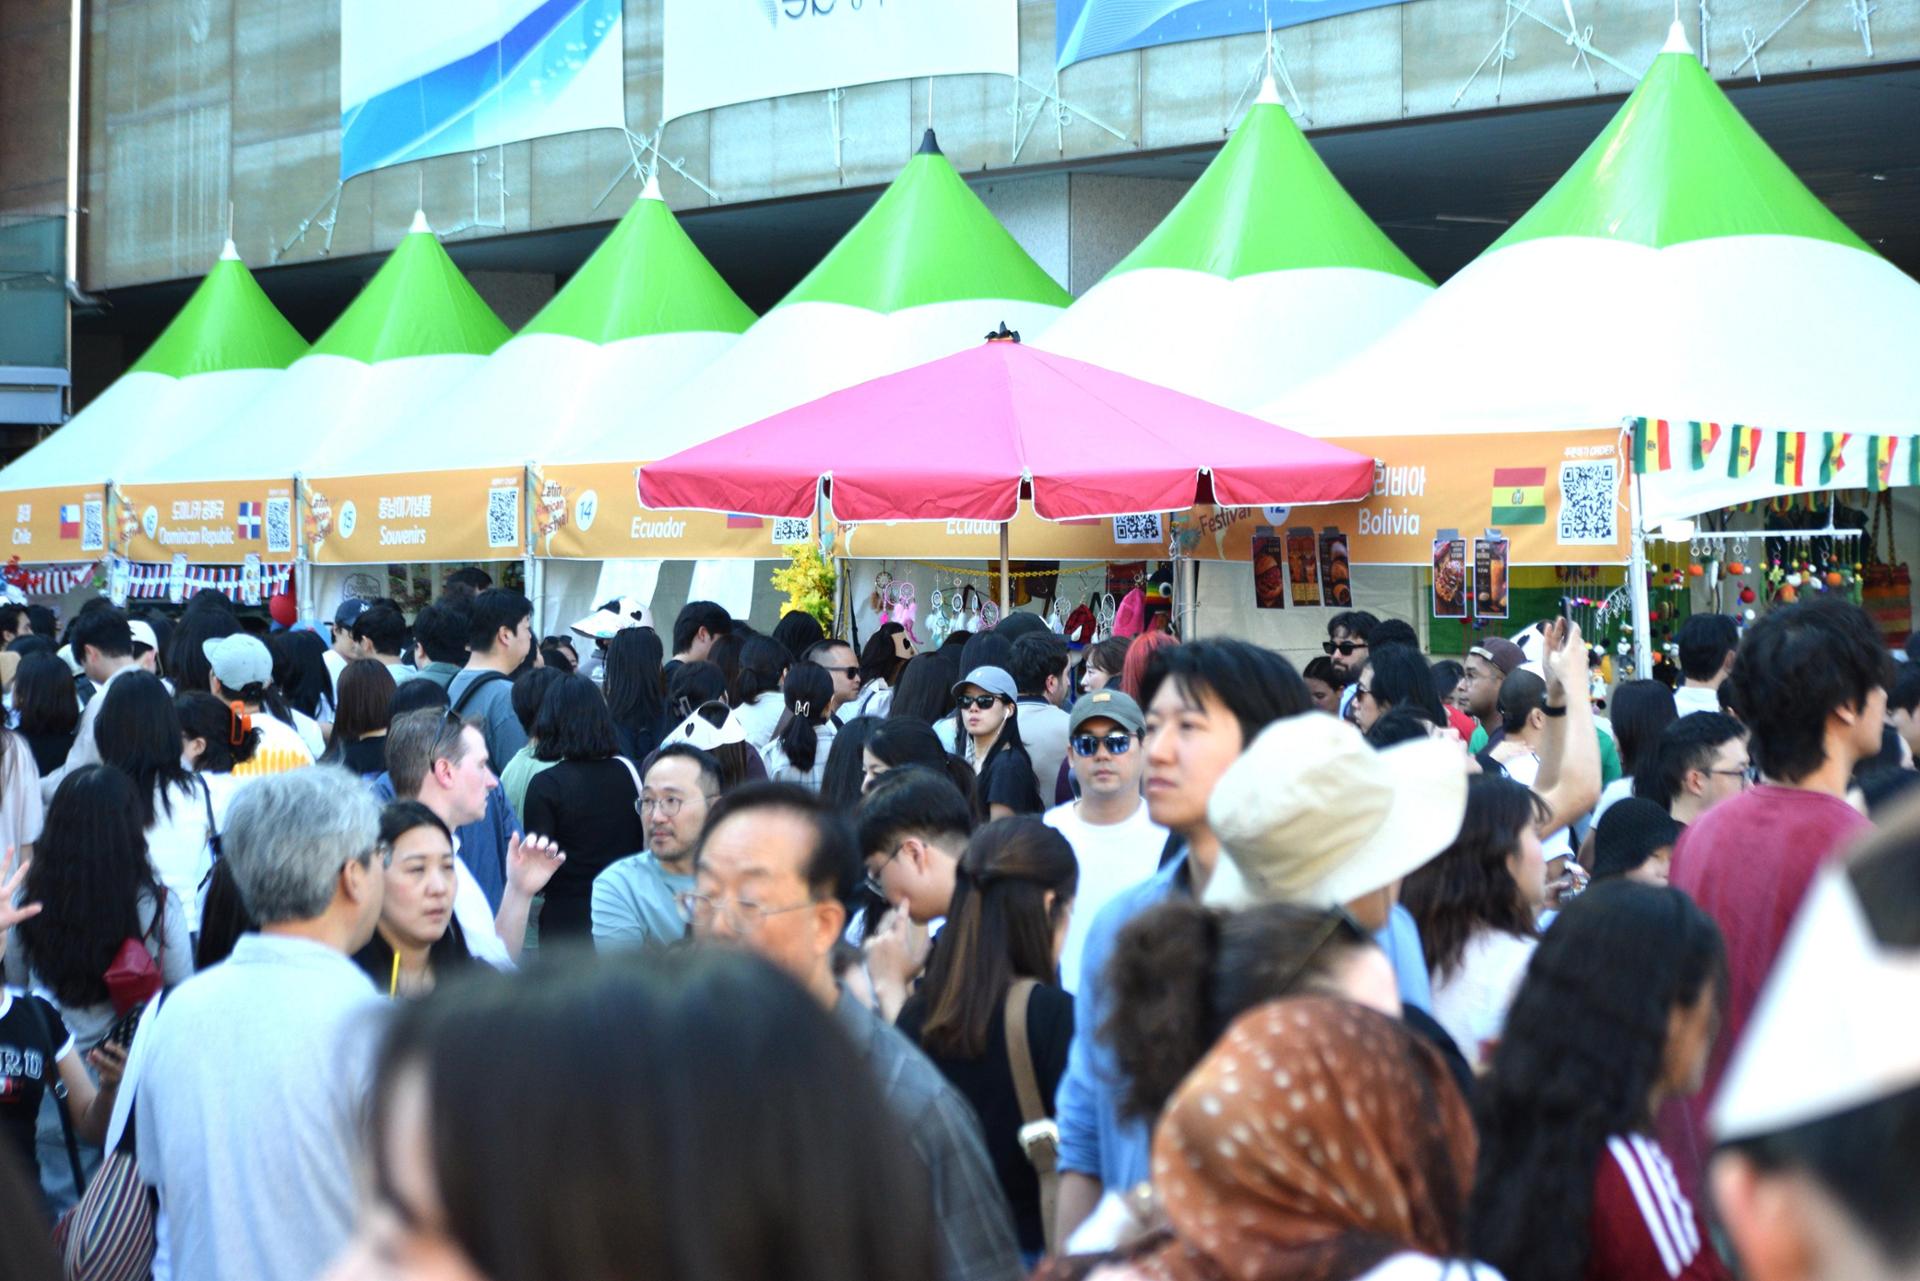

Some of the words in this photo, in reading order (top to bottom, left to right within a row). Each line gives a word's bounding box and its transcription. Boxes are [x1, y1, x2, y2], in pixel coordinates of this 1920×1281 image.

[1373, 464, 1426, 496] 리비아
[580, 501, 593, 521] 14
[1358, 507, 1420, 536] Bolivia
[159, 526, 200, 545] Dominican
[201, 525, 235, 548] Republic
[379, 526, 426, 545] Souvenirs
[631, 516, 687, 539] Ecuador
[945, 519, 1001, 536] Ecuado
